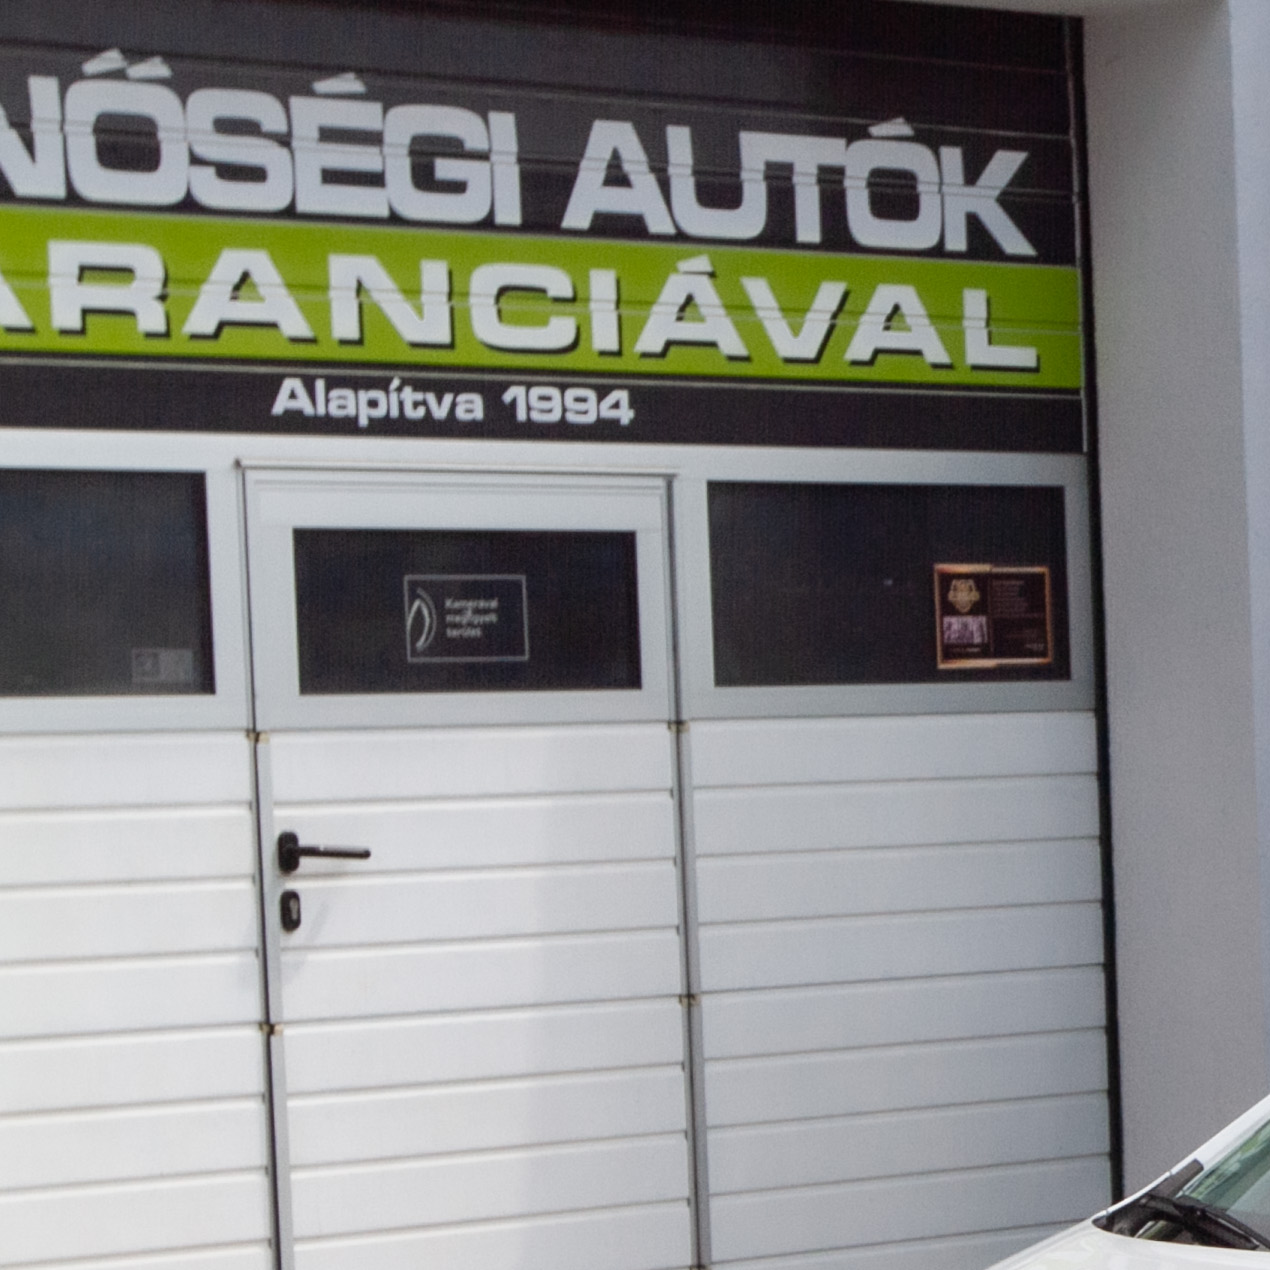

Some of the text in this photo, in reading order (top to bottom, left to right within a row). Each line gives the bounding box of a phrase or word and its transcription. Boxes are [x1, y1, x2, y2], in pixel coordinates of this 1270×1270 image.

[560, 116, 1038, 257] AUTÓK
[0, 238, 1040, 372] RANCIÁVAL
[270, 376, 635, 428] Alapítva 1994
